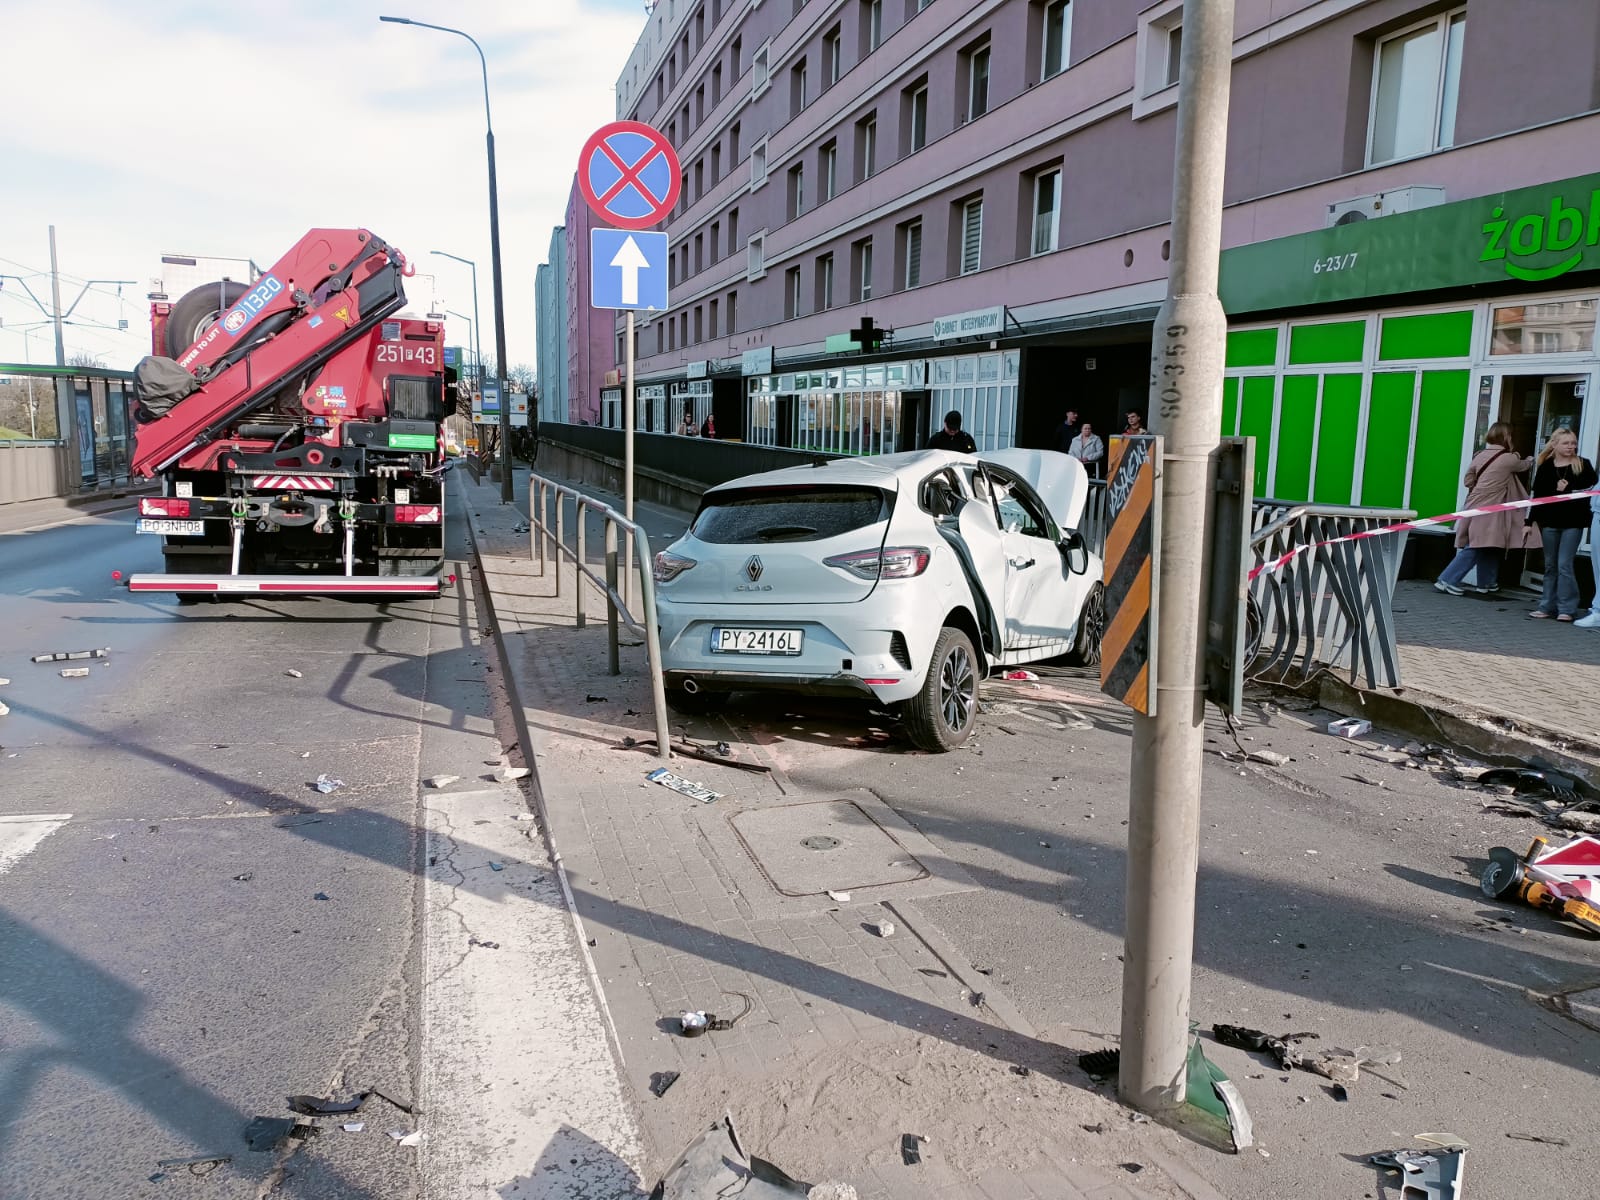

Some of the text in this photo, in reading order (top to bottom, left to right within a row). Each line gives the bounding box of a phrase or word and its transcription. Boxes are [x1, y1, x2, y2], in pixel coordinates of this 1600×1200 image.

[1313, 252, 1358, 274] 6-23/7
[225, 276, 282, 330] HMF 1320
[179, 327, 221, 368] OWER TO LIFT
[377, 344, 404, 363] 251
[415, 347, 435, 365] 43
[736, 584, 774, 592] CLIO
[721, 630, 796, 650] PY 2416L
